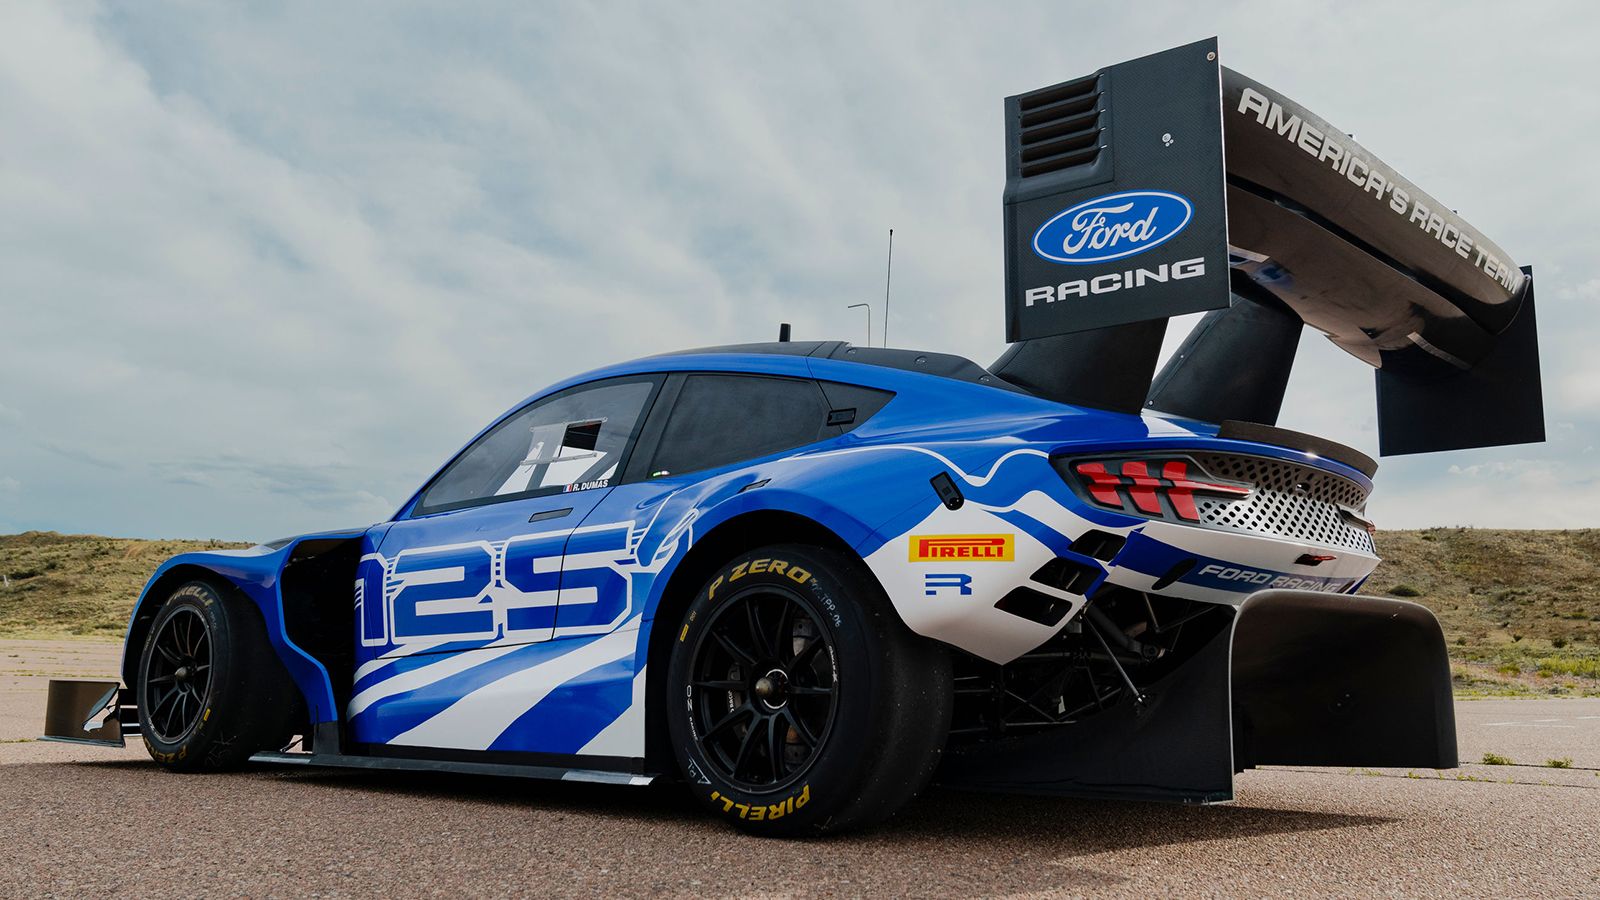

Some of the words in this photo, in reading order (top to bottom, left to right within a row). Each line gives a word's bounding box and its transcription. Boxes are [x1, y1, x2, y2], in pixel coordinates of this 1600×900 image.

[1237, 87, 1410, 215] AMERICA'S
[1409, 200, 1474, 259] RACE
[1474, 245, 1524, 294] TEAM
[1063, 201, 1157, 255] Ford
[1025, 256, 1205, 307] RACING
[572, 483, 580, 492] R.
[581, 479, 609, 491] DUMAS
[919, 538, 1005, 558] PIRELLI
[354, 520, 636, 647] 125
[708, 575, 724, 601] P
[728, 558, 812, 584] ZERO
[1198, 564, 1272, 585] FORD
[1270, 575, 1342, 593] RACING
[710, 783, 811, 821] PIRELLI
